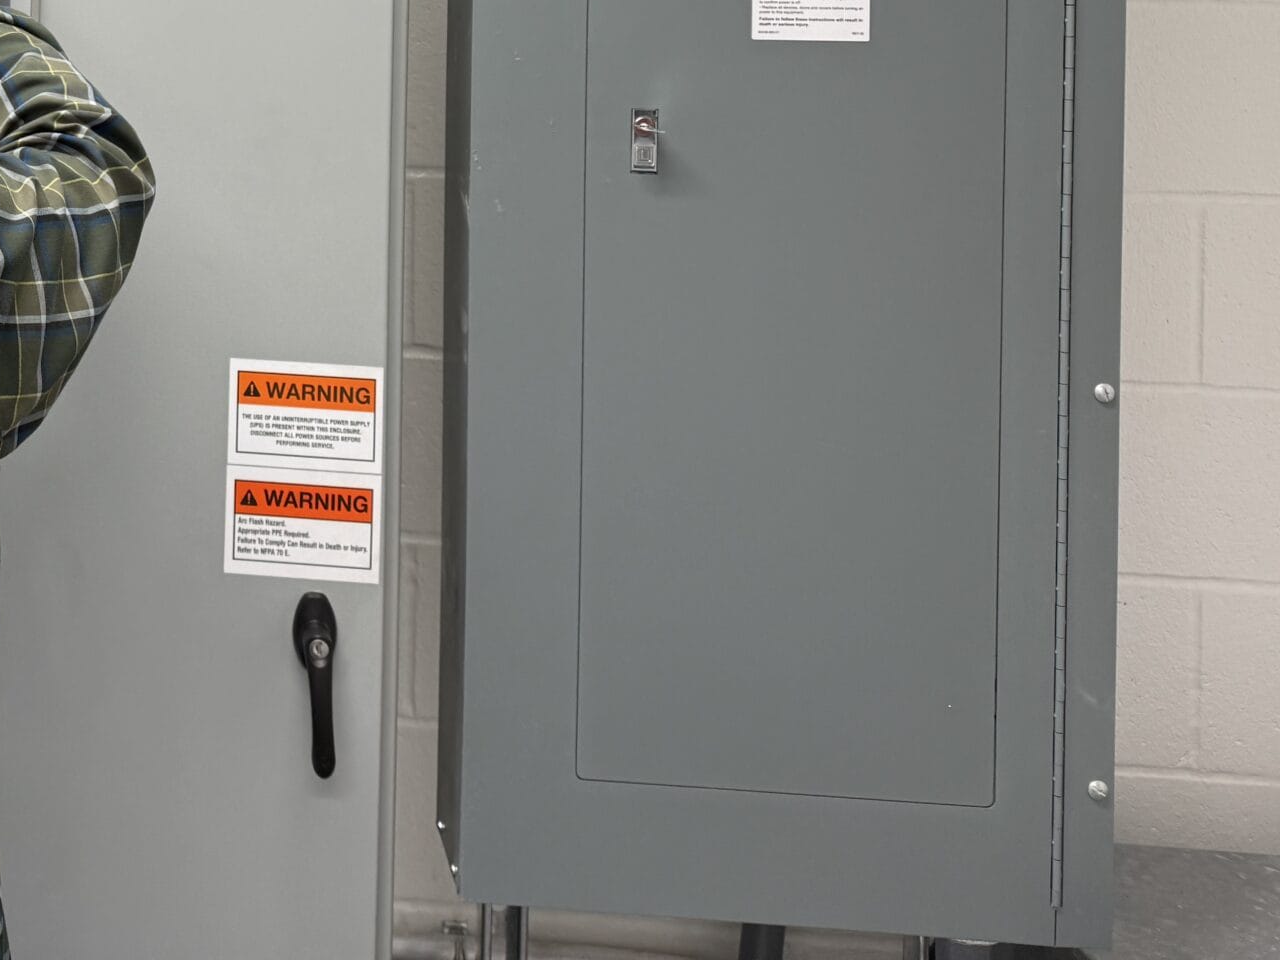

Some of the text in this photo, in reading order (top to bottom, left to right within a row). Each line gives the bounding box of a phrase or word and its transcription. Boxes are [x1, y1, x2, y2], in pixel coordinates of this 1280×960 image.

[266, 382, 371, 404] WARNING
[282, 416, 328, 424] UNINTERRUPTIBLE
[276, 440, 310, 448] PERFORMING
[264, 490, 368, 513] WARNING
[238, 527, 270, 536] Appropriate
[284, 530, 310, 539] Required.
[265, 538, 286, 548] Comply
[300, 540, 317, 549] Result
[325, 542, 342, 550] Death
[350, 544, 368, 554] Injury.
